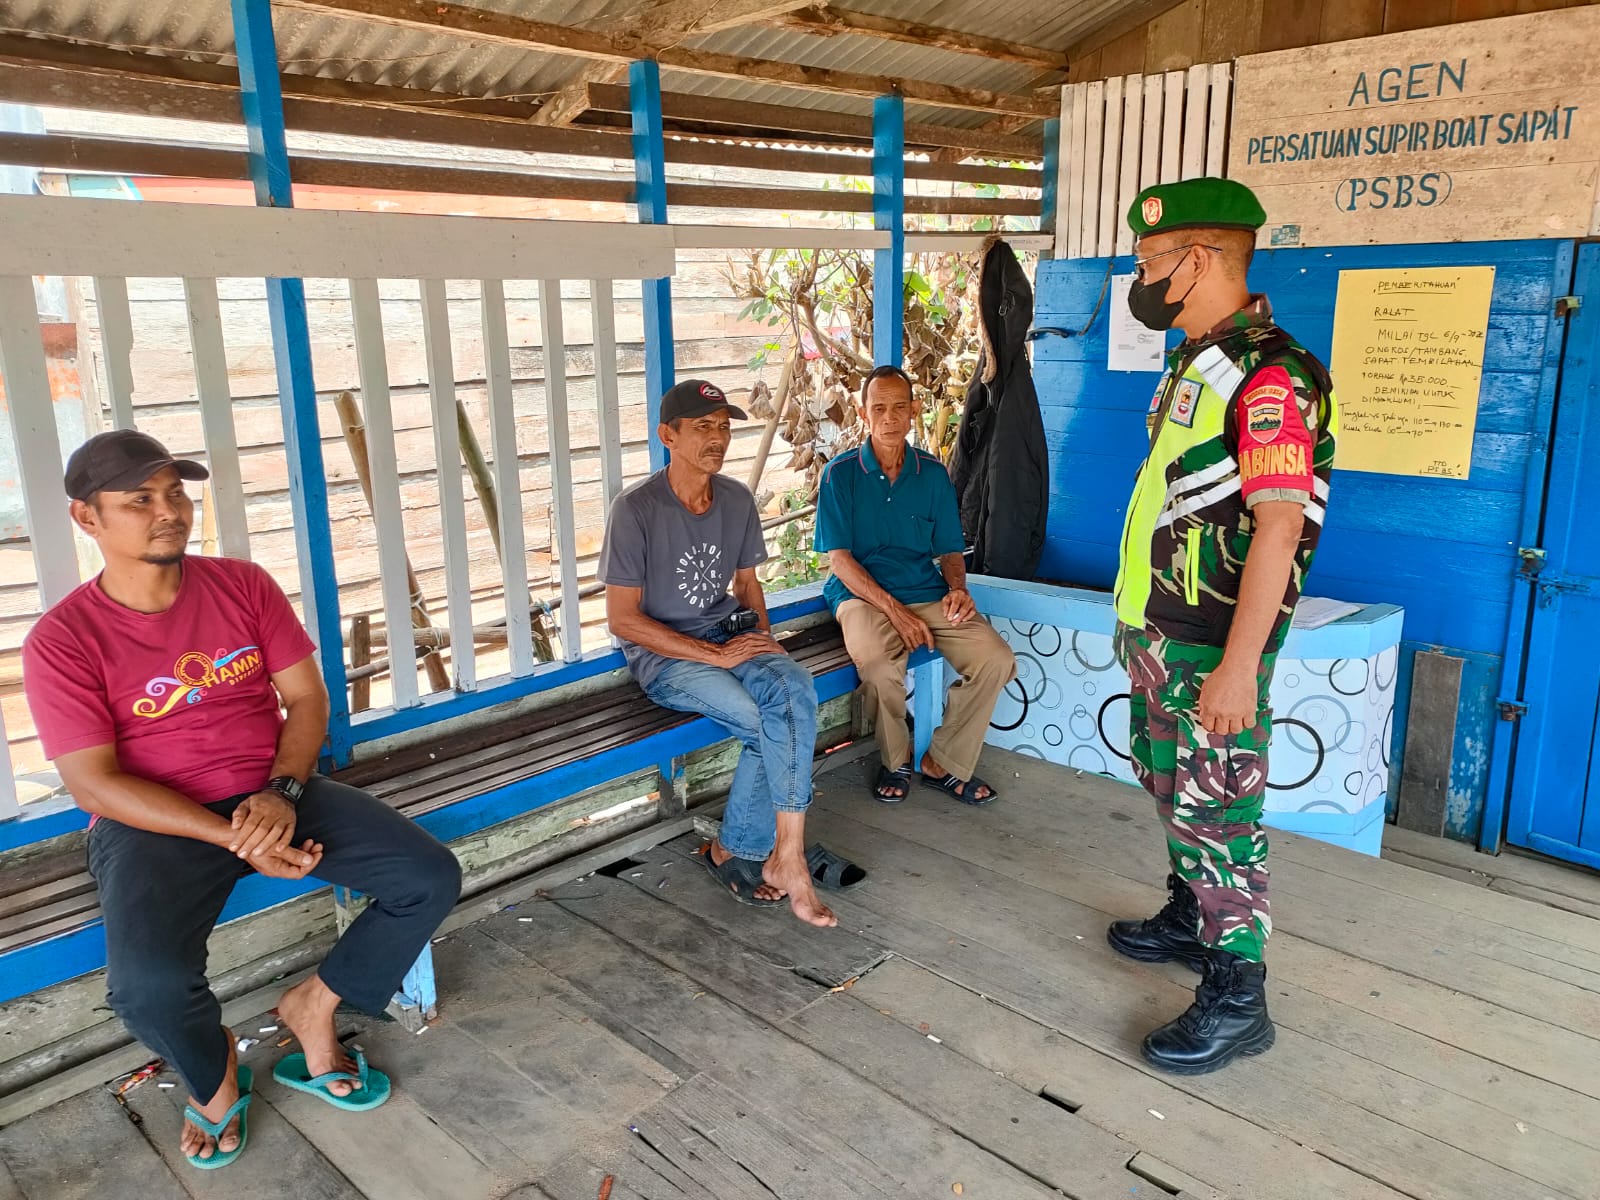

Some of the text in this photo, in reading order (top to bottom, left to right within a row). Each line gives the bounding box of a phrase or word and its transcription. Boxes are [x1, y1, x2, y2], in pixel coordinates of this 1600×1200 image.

[1347, 58, 1468, 107] AGEN
[1247, 106, 1579, 165] PERSATUAN SUPIR BOAT SAPAT
[1335, 171, 1453, 213] (PSBS)
[1374, 306, 1416, 317] RALAT
[1238, 443, 1307, 482] ABINSA
